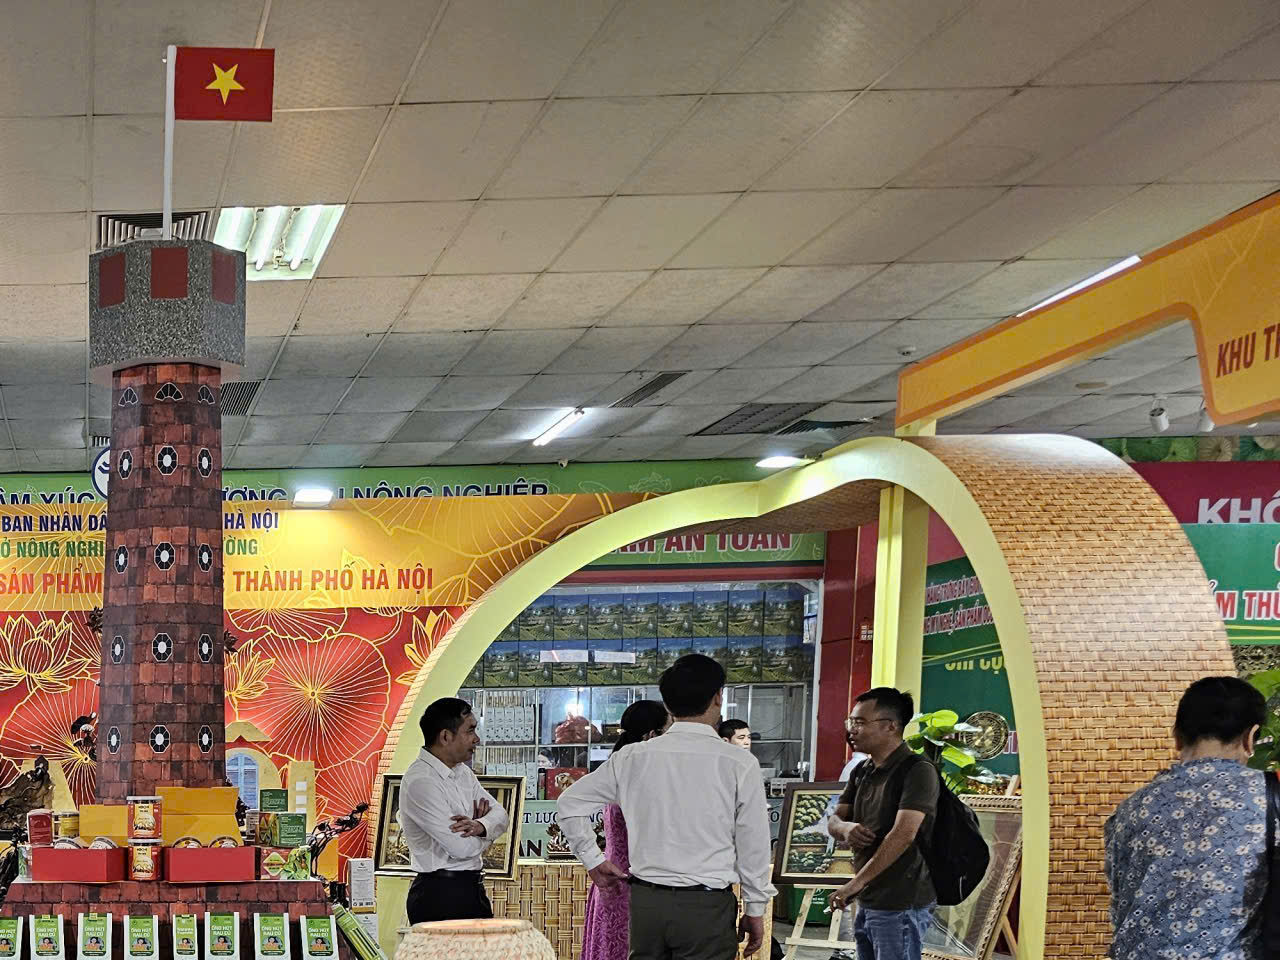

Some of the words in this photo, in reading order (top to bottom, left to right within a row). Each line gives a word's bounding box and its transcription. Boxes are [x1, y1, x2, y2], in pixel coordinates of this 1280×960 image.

[1216, 331, 1256, 378] KHU
[1, 515, 33, 532] BAN
[39, 510, 82, 532] NHÂN
[88, 510, 107, 531] DÂ
[224, 508, 246, 530] HÀ
[251, 508, 279, 533] NỘI
[16, 536, 60, 558] NÔNG
[65, 540, 104, 558] NGHI
[42, 563, 103, 595] PHẨM
[232, 566, 303, 593] THÀNH
[311, 561, 354, 592] PHỐ
[361, 563, 390, 591] HÀ
[396, 562, 434, 595] NỘI
